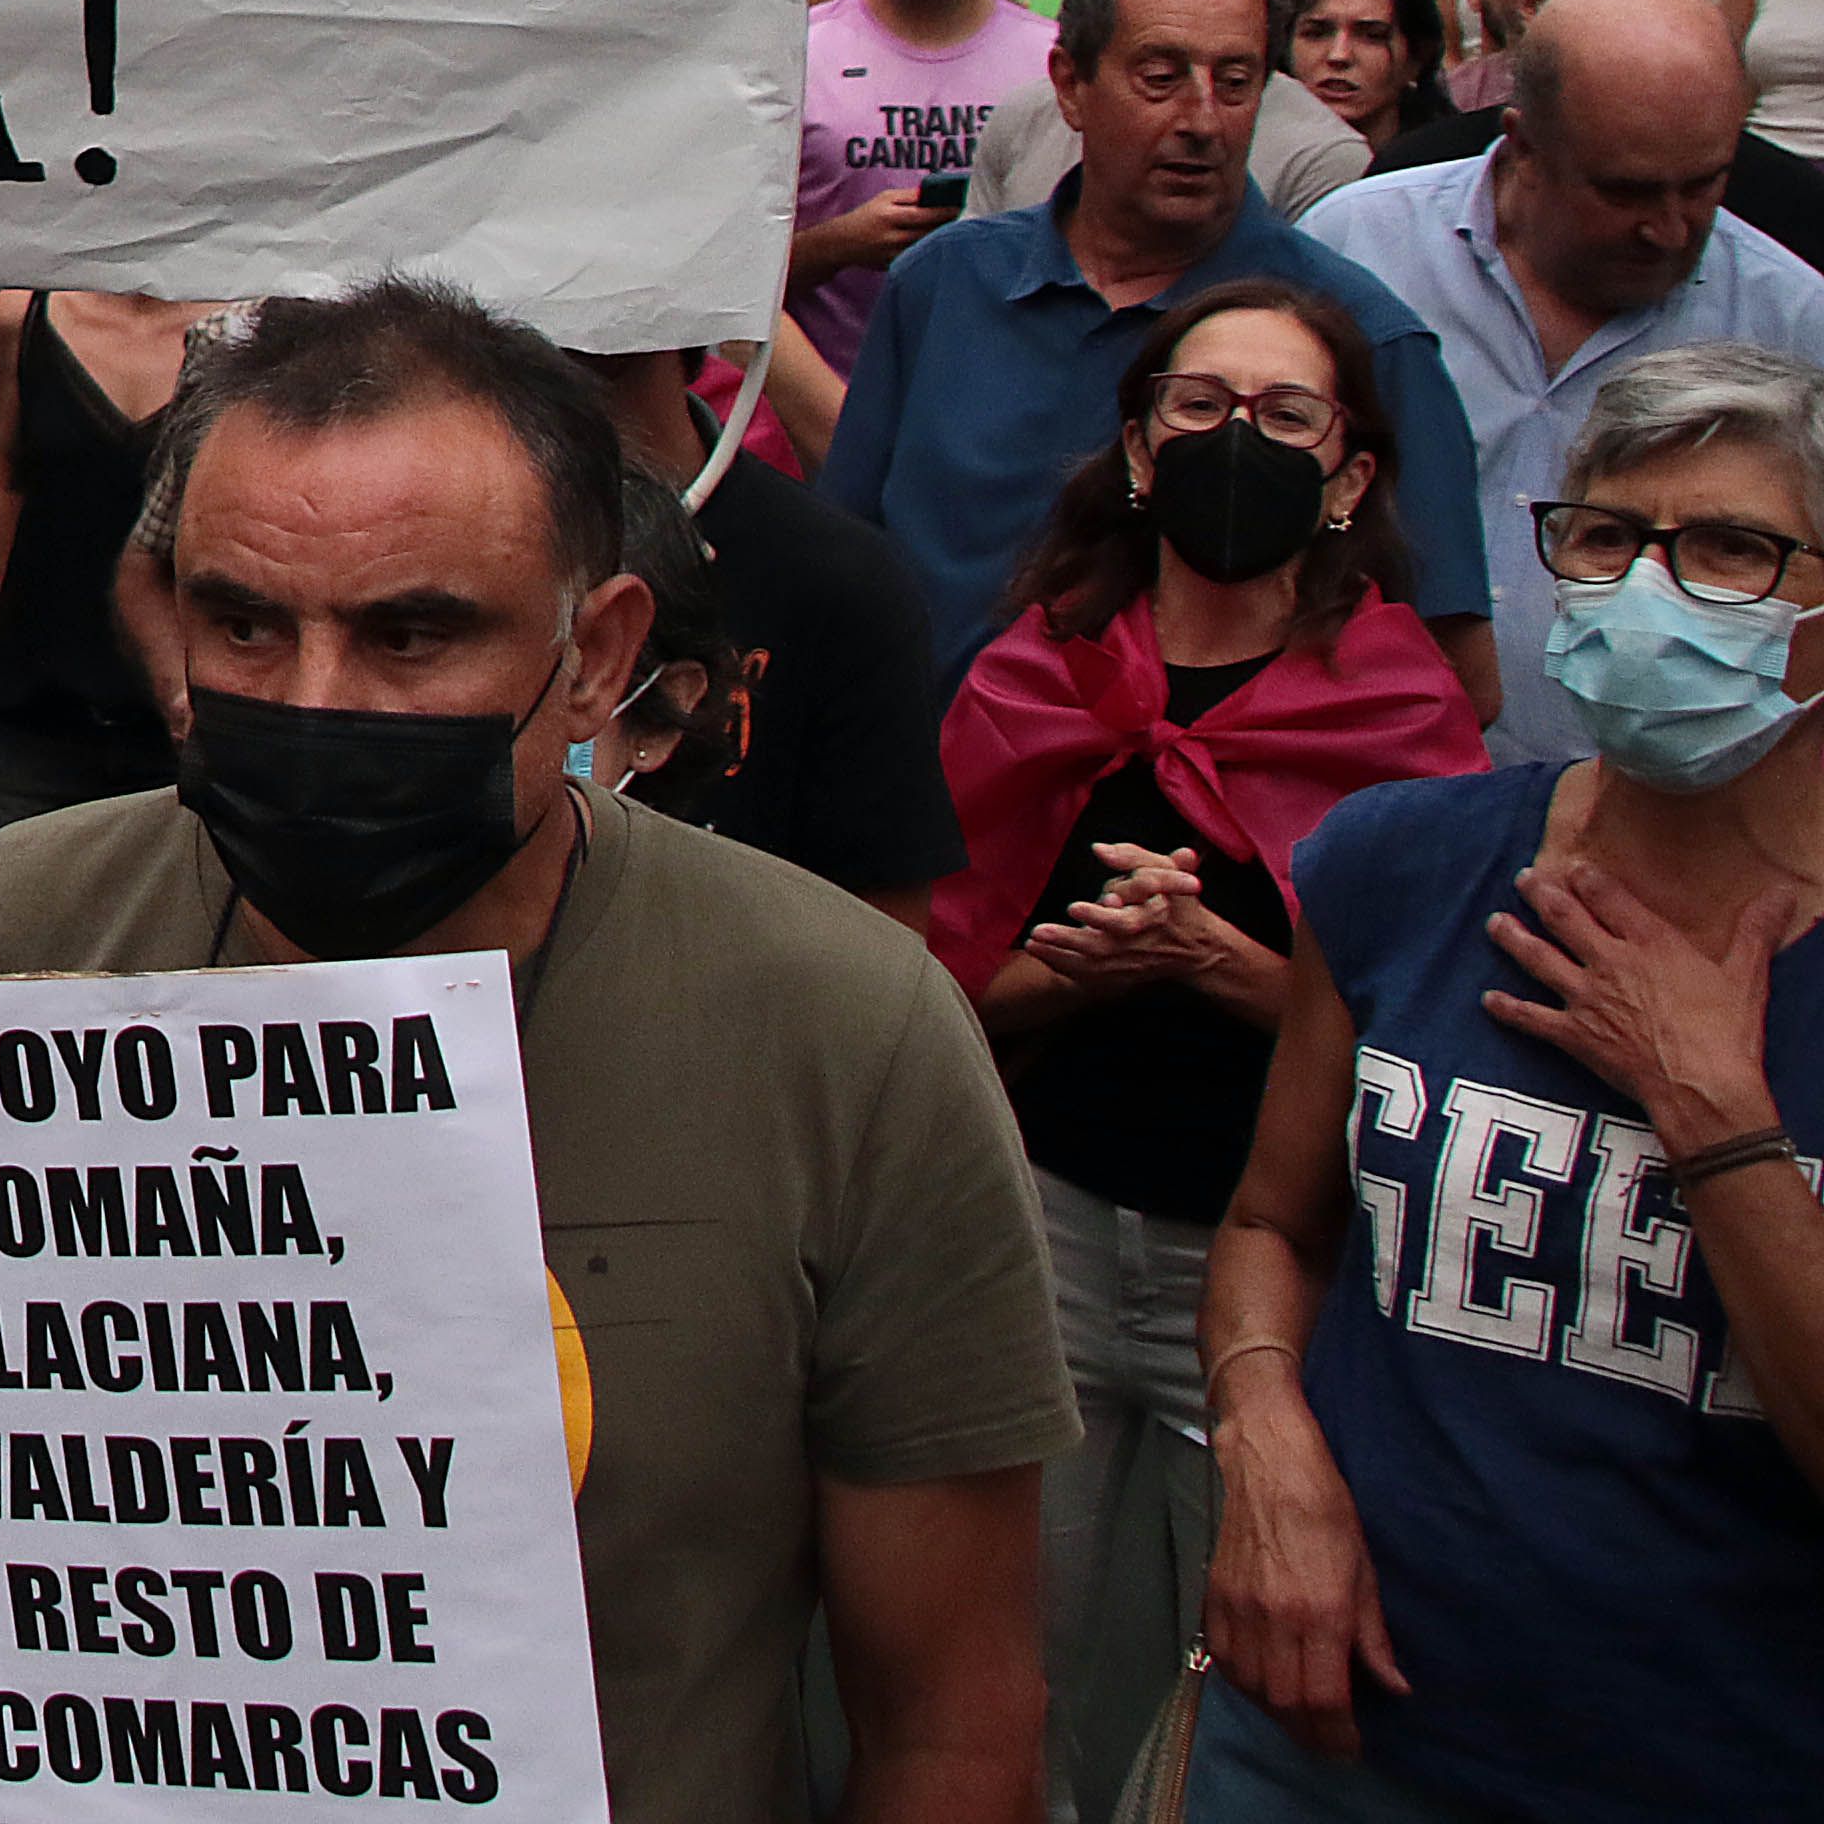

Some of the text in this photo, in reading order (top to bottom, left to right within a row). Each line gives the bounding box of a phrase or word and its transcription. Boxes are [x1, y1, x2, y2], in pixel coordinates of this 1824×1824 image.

[199, 1012, 457, 1119] PARA
[395, 1437, 455, 1529] Y
[5, 1562, 436, 1664] RESTO DE
